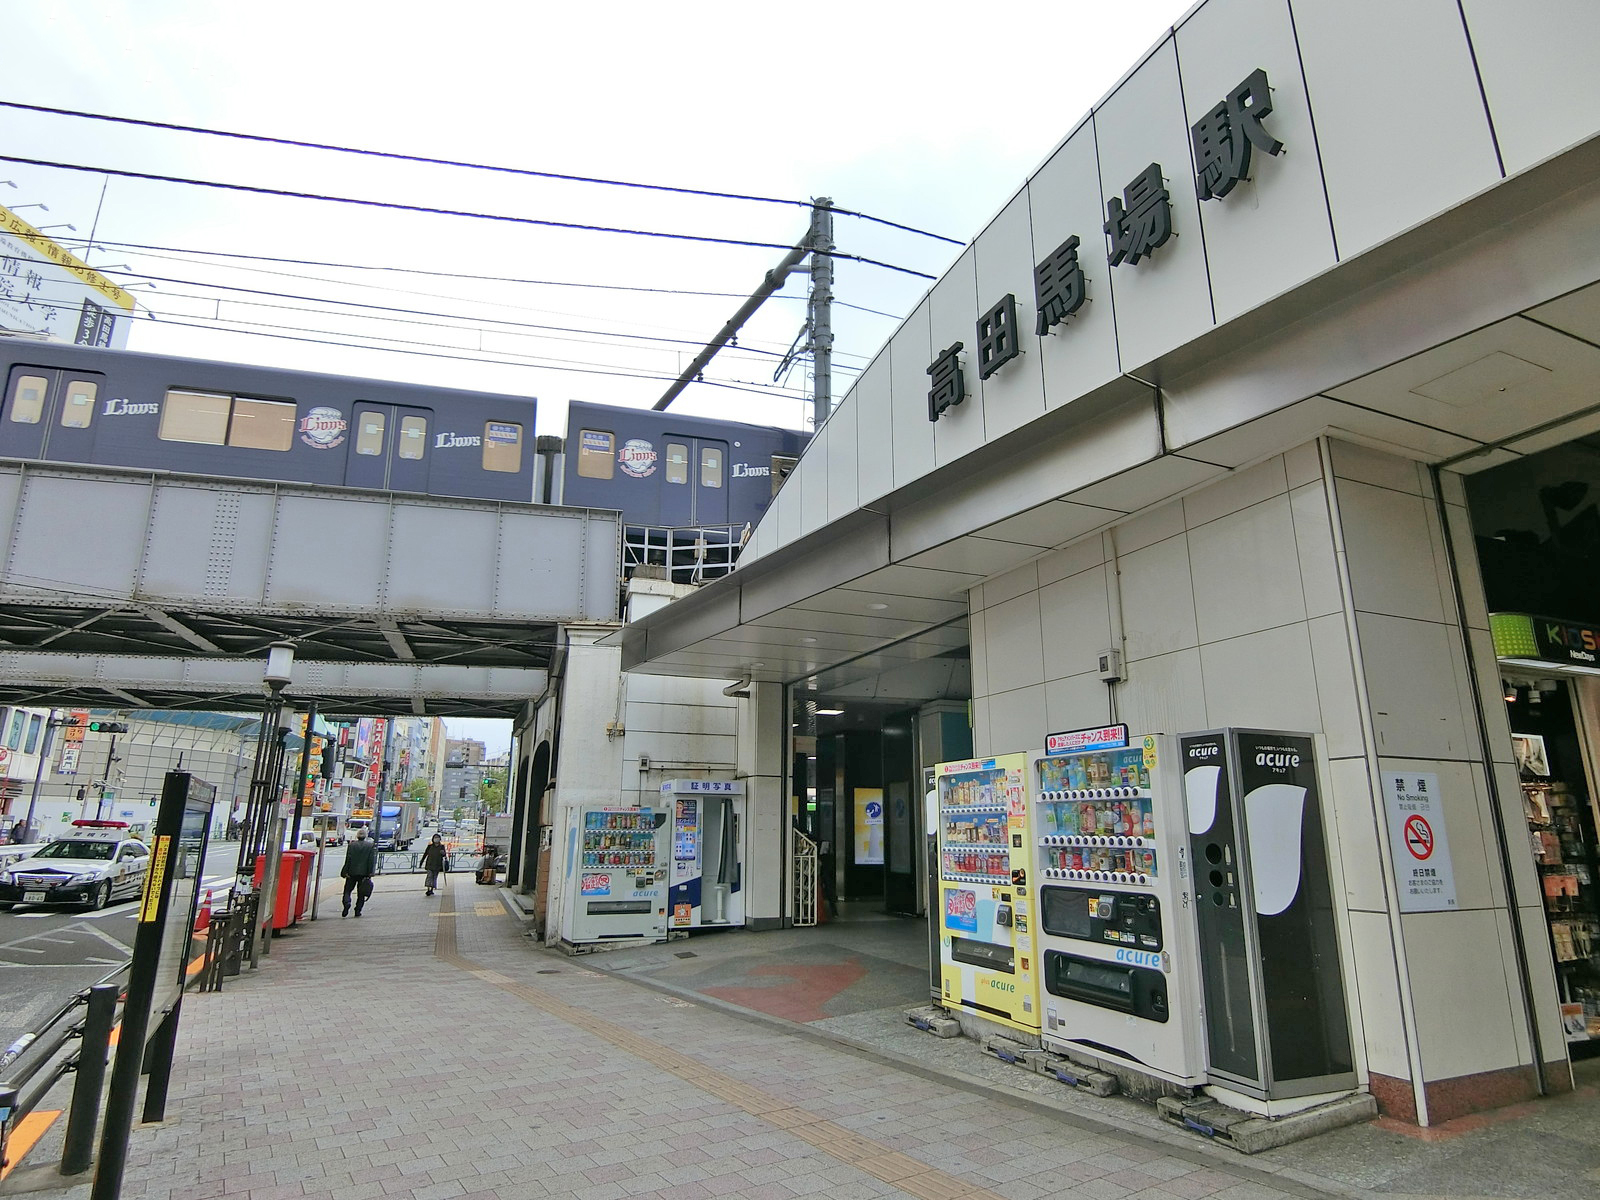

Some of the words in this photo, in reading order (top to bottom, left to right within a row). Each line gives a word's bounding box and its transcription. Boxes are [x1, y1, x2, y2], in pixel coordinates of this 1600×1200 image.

[926, 67, 1284, 423] 高田馬場駅
[103, 398, 159, 416] Lions
[299, 416, 347, 432] Lions
[435, 432, 481, 449] Lions
[618, 448, 657, 462] Lions
[732, 462, 770, 479] Lions
[1189, 746, 1218, 757] acure
[1123, 755, 1142, 764] acur
[1256, 753, 1300, 767] acure
[691, 781, 732, 790] 証明写真
[1395, 778, 1427, 792] 禁煙
[1406, 794, 1429, 803] Smoking
[633, 889, 658, 897] acure
[1116, 948, 1160, 967] acure
[991, 979, 1015, 993] acure
